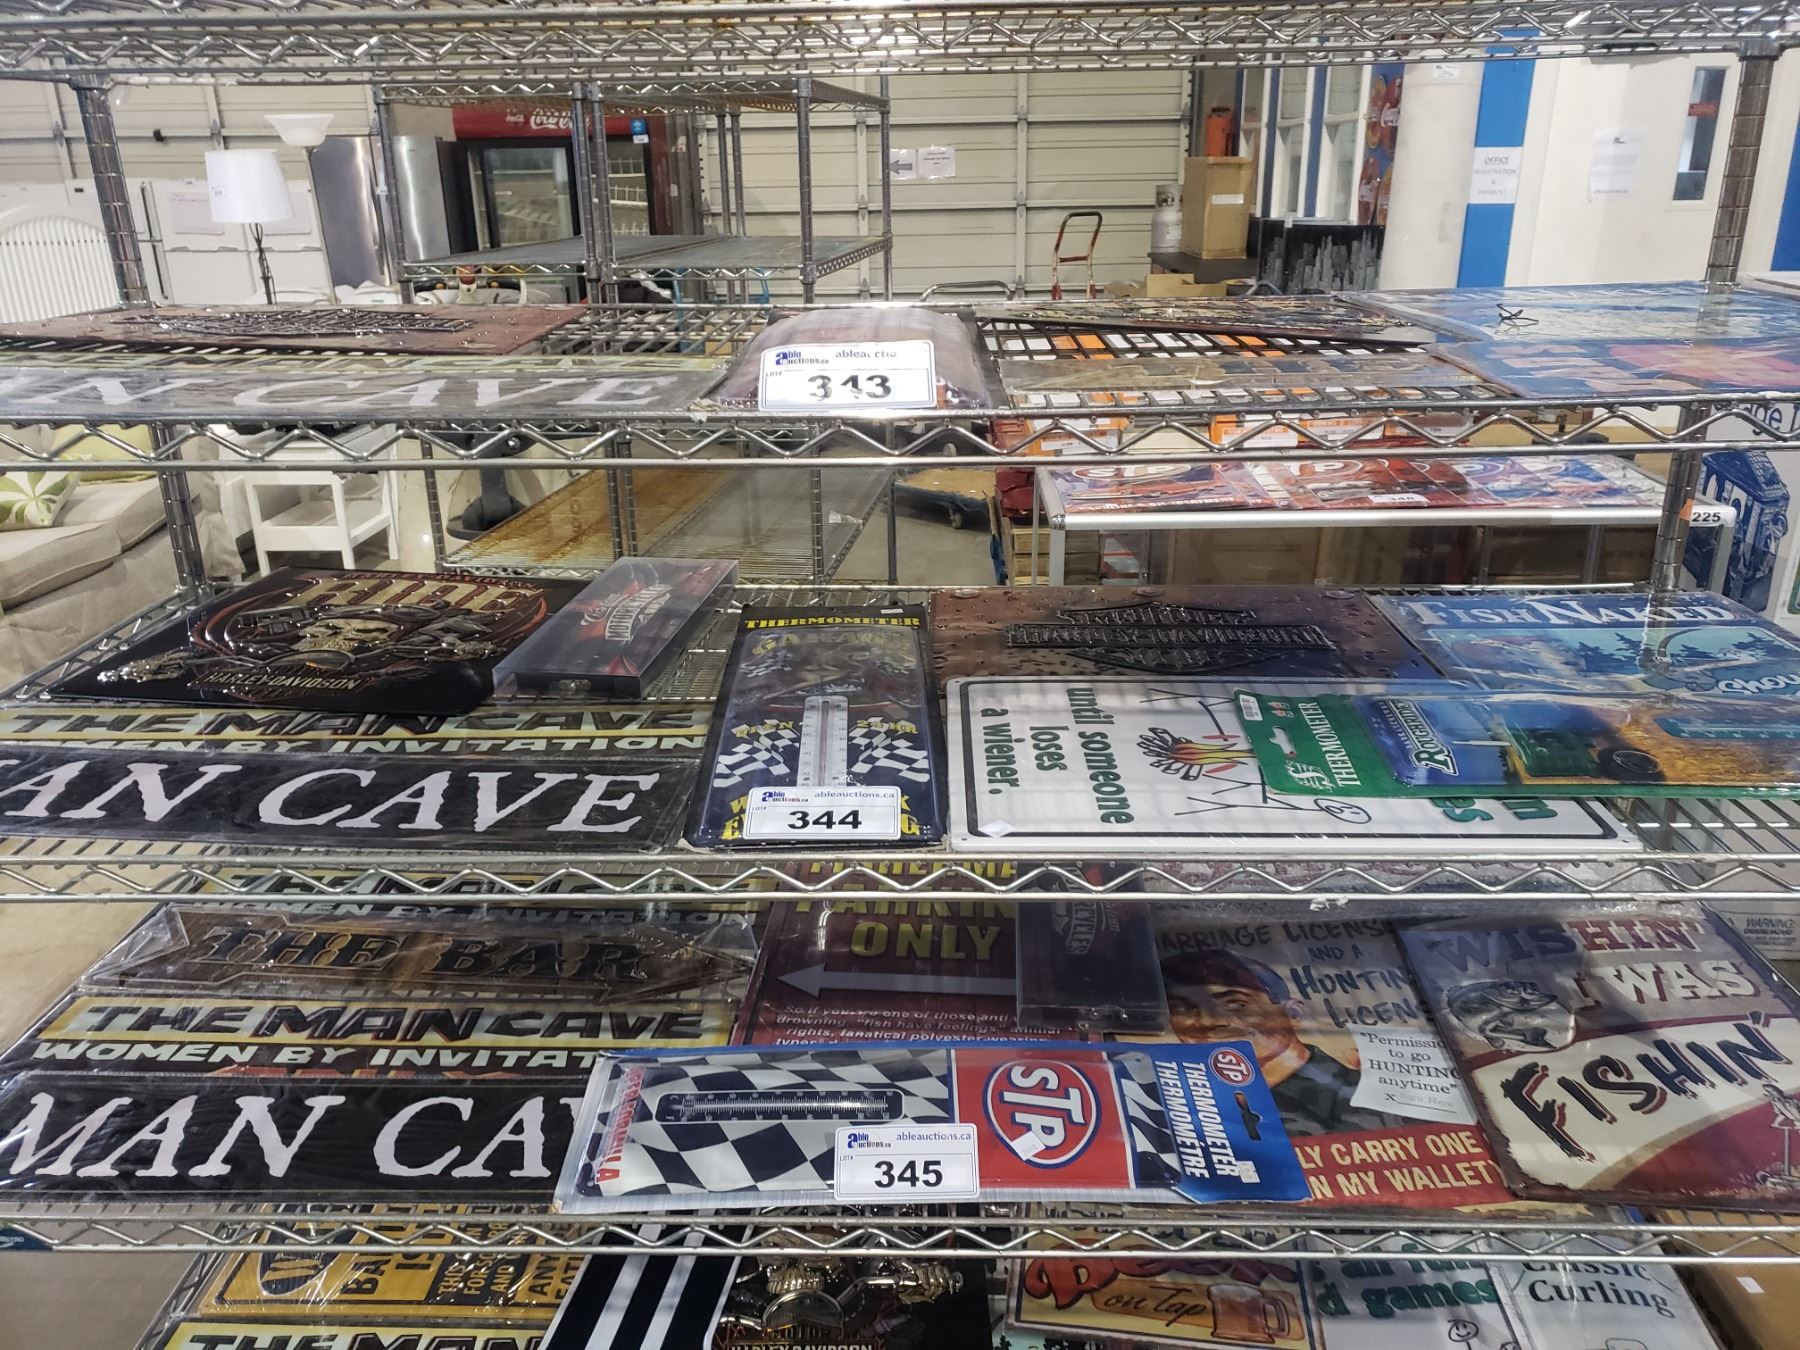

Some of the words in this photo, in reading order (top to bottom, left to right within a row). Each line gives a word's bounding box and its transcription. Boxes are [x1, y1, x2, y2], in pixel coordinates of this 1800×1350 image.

[1691, 512, 1721, 522] 225
[744, 616, 921, 629] THERMOMETER
[1533, 600, 1738, 626] NAKED
[205, 672, 362, 690] HARLEY-DAVIDSON
[12, 713, 199, 733] THE
[196, 712, 448, 737] MAN
[455, 711, 698, 731] CAVE
[980, 707, 1009, 718] a
[1066, 686, 1115, 726] until
[235, 740, 305, 753] BY
[332, 737, 707, 754] INVITATION
[1028, 725, 1070, 772] loses
[1297, 702, 1362, 788] THERMOMETER
[1394, 700, 1459, 776] ROUGHRIDE
[982, 722, 1026, 796] wiener.
[1077, 727, 1136, 825] someone
[258, 768, 661, 833] CAVE
[813, 790, 895, 799] ableauctions.ca
[786, 809, 863, 830] 344
[795, 883, 1017, 919] PARKIN
[194, 928, 408, 971] THE
[421, 936, 650, 979] BAR
[850, 921, 1001, 961] ONLY
[1157, 925, 1273, 951] ARRIAGE
[1288, 964, 1410, 1000] HUNTIN
[1599, 959, 1761, 1005] WAS
[76, 1005, 256, 1034] THE
[250, 1005, 486, 1042] MAN
[487, 1010, 704, 1040] CAVE
[1322, 997, 1420, 1030] LICEN
[33, 1041, 260, 1064] WOMEN
[283, 1046, 355, 1066] BY
[368, 1048, 597, 1068] INVITAT
[1359, 1032, 1447, 1049] "Permissio
[1388, 1048, 1405, 1059] to
[1410, 1051, 1431, 1063] go
[1216, 1052, 1251, 1082] STP
[1499, 1009, 1795, 1164] FISHIN'
[1006, 1063, 1086, 1150] STP
[1181, 1060, 1243, 1177] THERMOMETER
[9, 1091, 347, 1178] MAN
[896, 1131, 972, 1142] ableauctions.ca
[1330, 1136, 1420, 1166] CARRY
[1424, 1130, 1484, 1157] ONE
[874, 1160, 943, 1189] 345
[1336, 1170, 1381, 1197] MY
[1103, 1293, 1148, 1311] on
[1147, 1285, 1208, 1328] Tap
[1361, 1278, 1501, 1319] games
[1528, 1279, 1677, 1319] Curling
